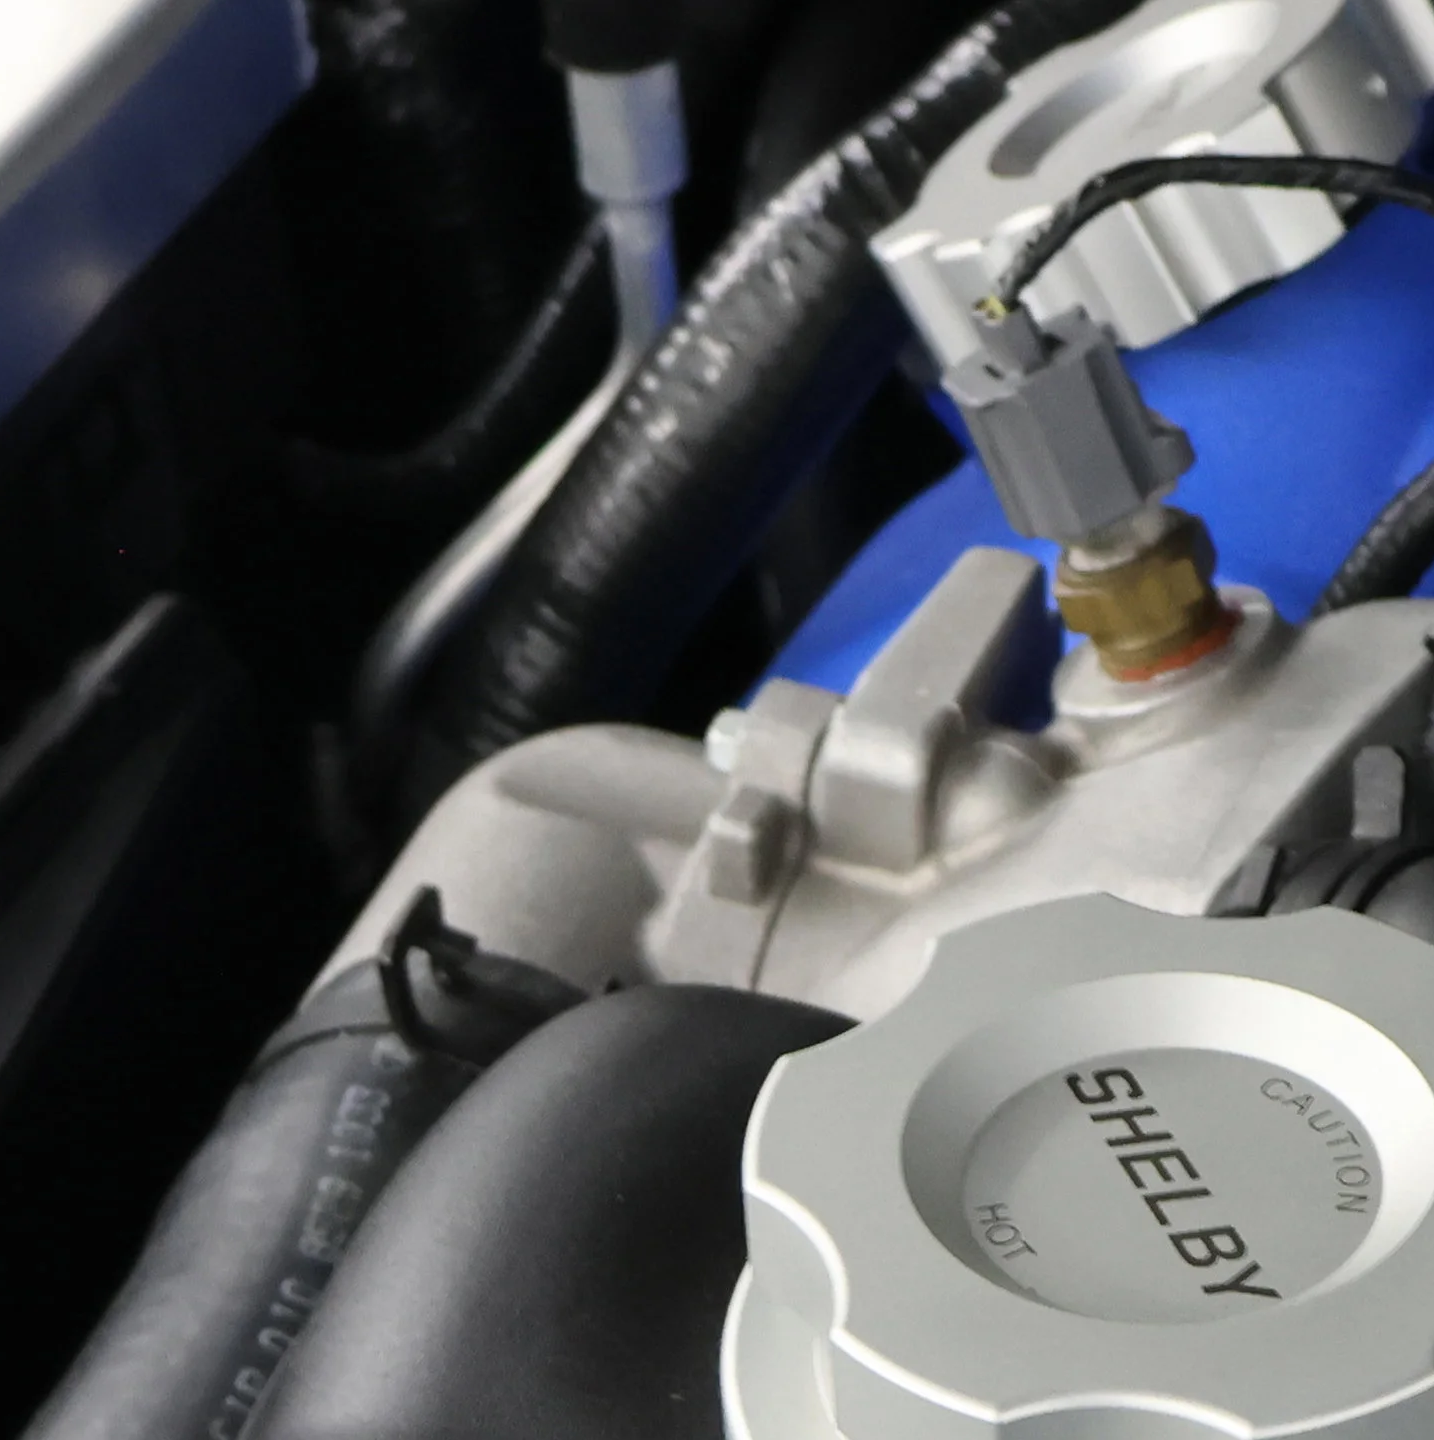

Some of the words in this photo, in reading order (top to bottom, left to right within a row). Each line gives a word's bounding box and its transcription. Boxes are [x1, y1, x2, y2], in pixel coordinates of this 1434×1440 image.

[1065, 1065, 1283, 1301] SHELBY
[1259, 1075, 1373, 1215] CAUTION
[975, 1200, 1038, 1261] HOT
